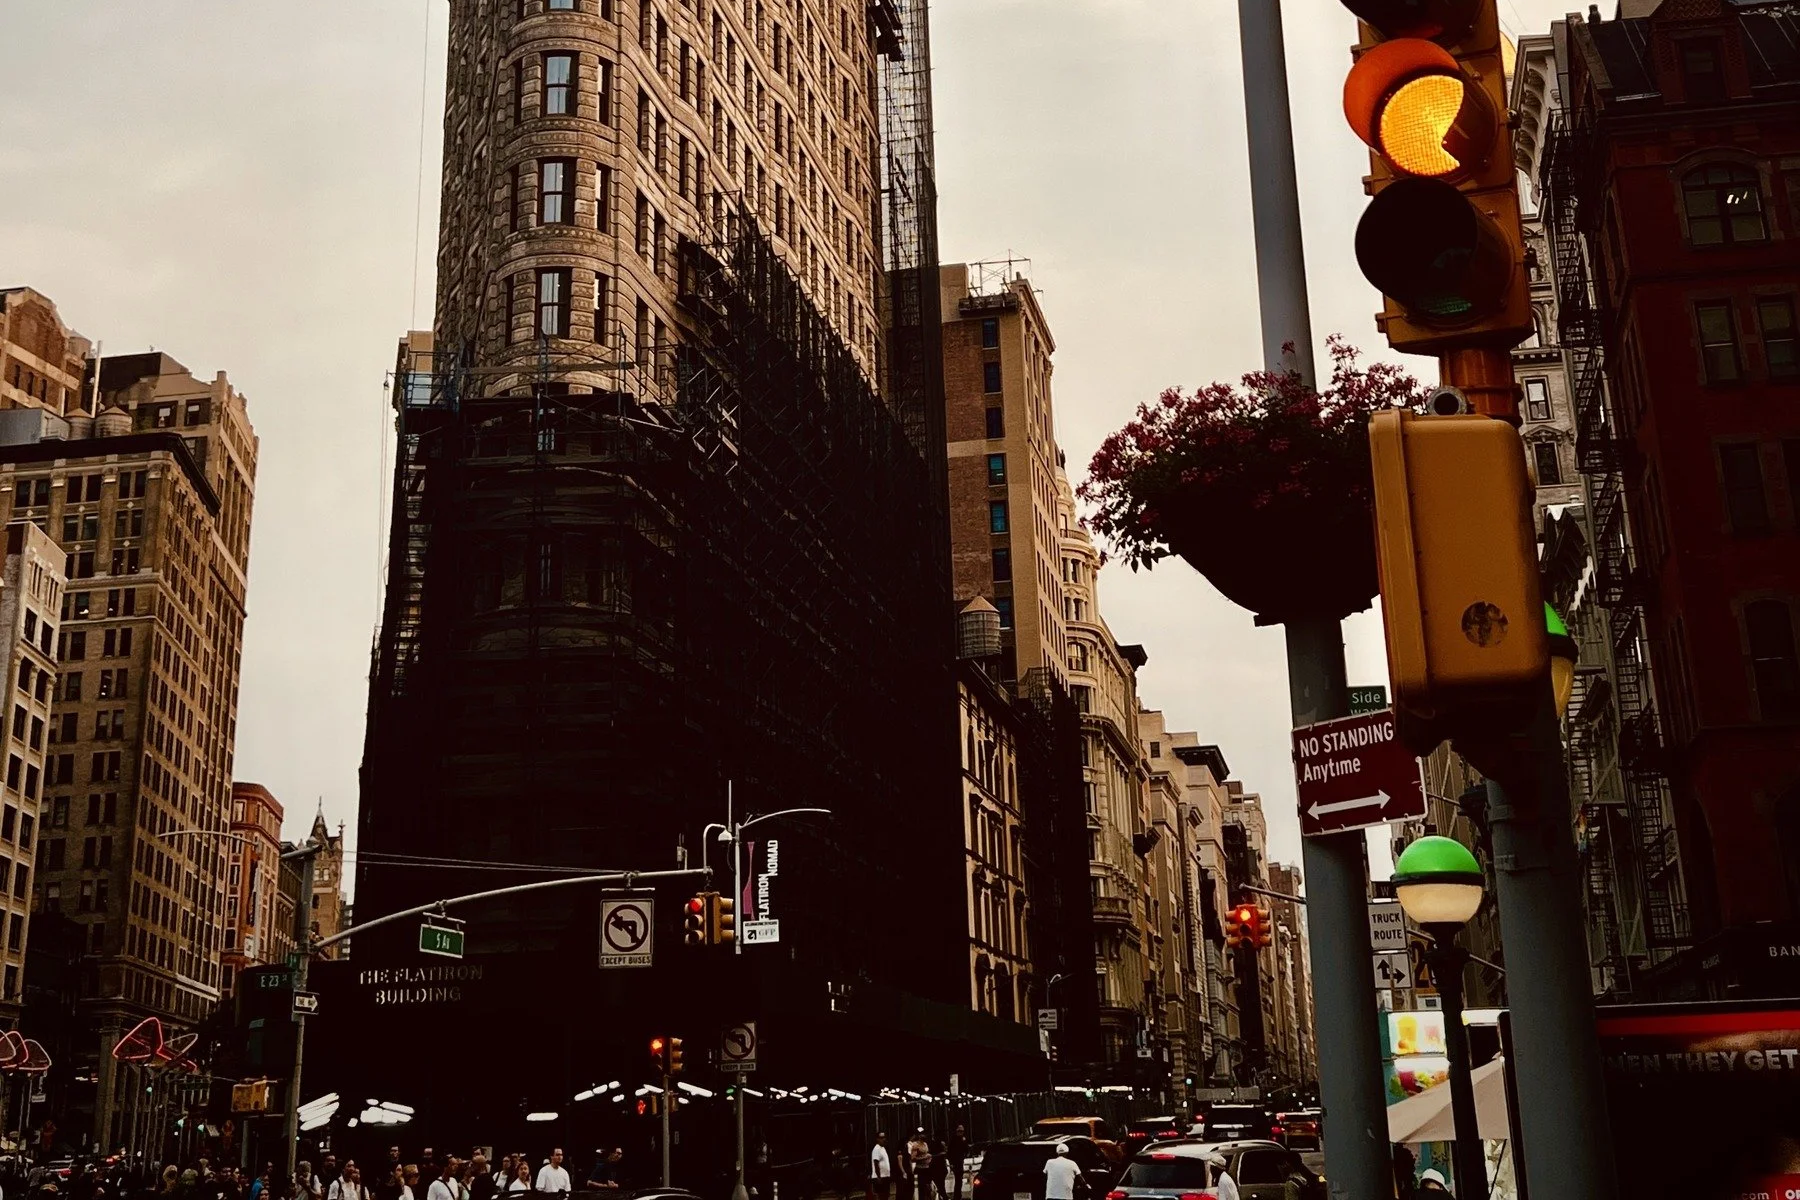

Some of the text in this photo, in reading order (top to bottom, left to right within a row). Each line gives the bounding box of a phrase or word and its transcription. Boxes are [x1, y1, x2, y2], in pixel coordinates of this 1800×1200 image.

[1352, 691, 1381, 704] Side
[1299, 721, 1394, 758] NO STANDING
[1303, 757, 1361, 783] Anytime
[767, 839, 779, 877] NOMAD
[758, 873, 770, 921] FLATIRON
[1372, 913, 1401, 923] TRUCK
[1374, 929, 1403, 940] ROUTE
[601, 956, 651, 965] EXCEPT BUSES
[269, 975, 279, 987] 23
[360, 969, 390, 984] THE
[375, 986, 461, 1005] BUILDING
[1666, 1051, 1739, 1072] THEY
[1744, 1048, 1799, 1071] GET
